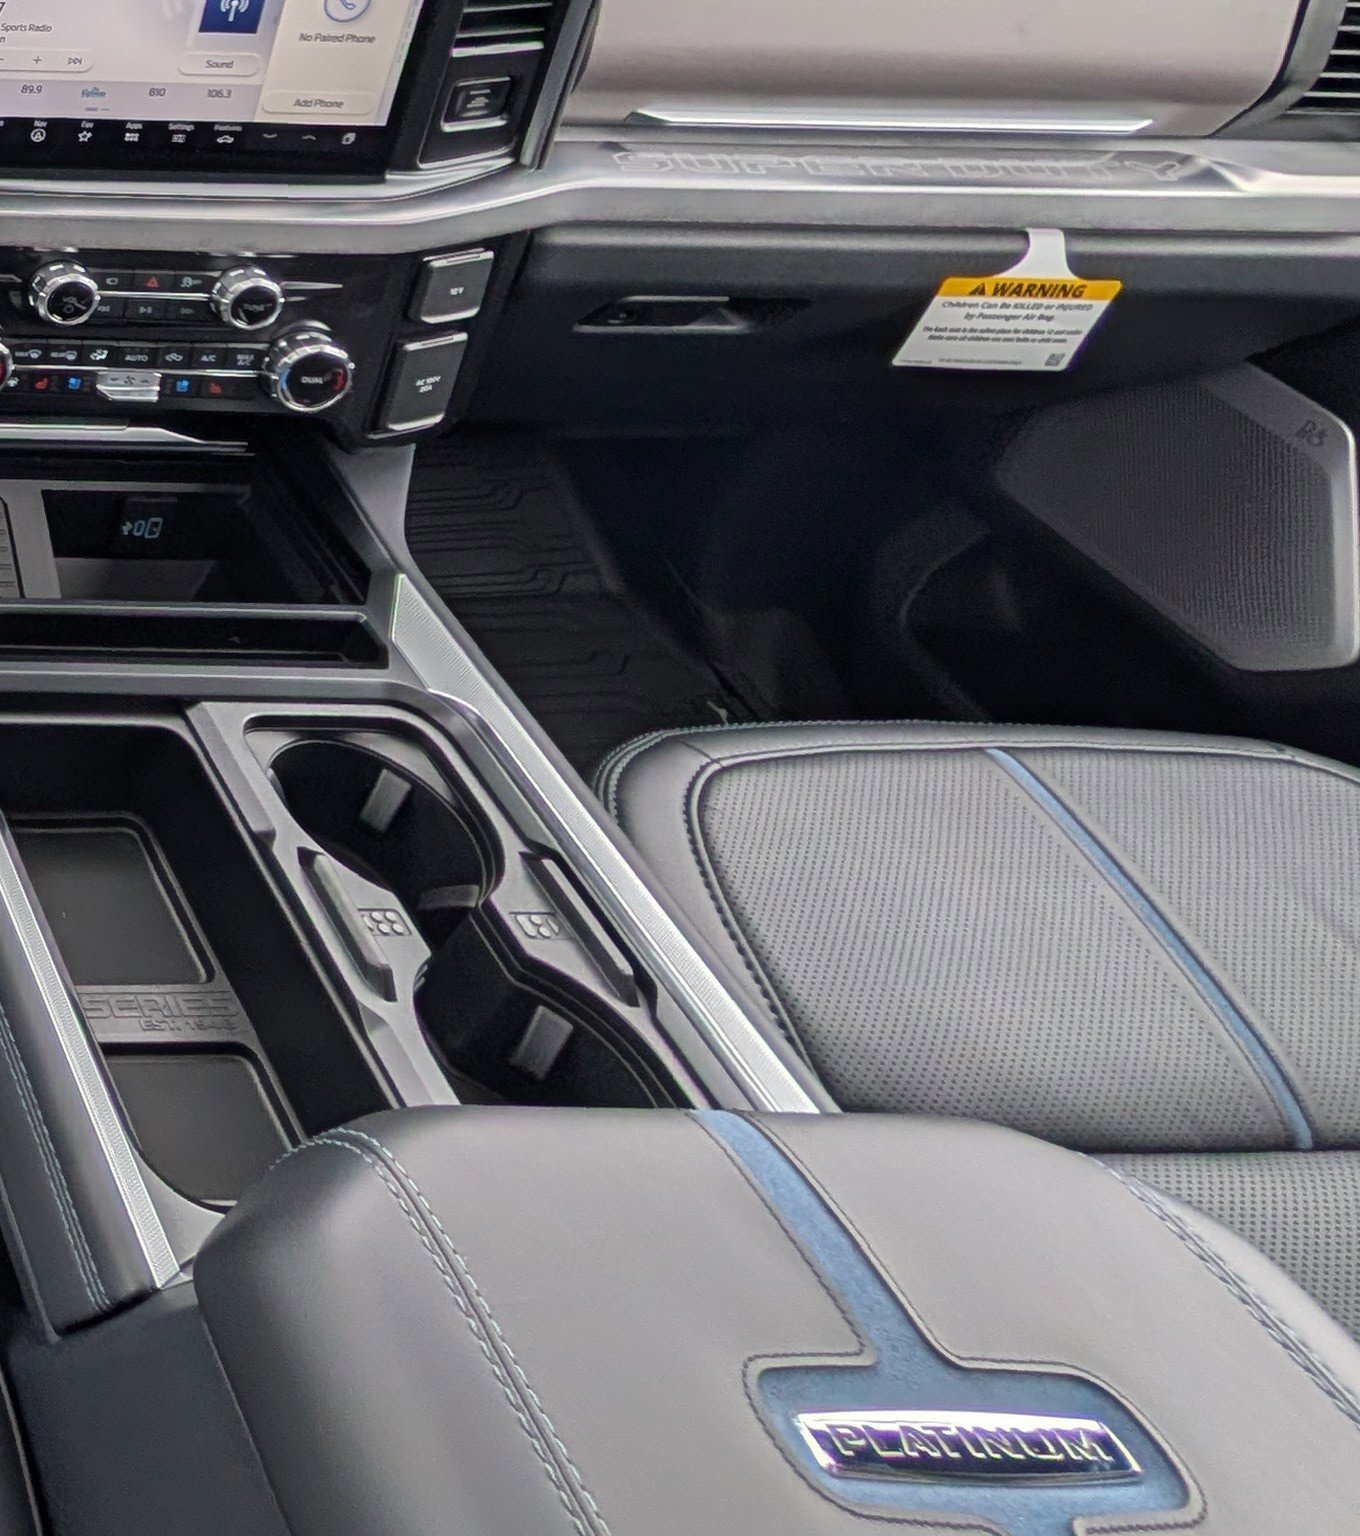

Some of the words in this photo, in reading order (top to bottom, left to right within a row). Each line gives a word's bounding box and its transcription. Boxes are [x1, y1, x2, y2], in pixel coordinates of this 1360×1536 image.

[0, 22, 28, 34] Sports
[28, 23, 53, 33] Radio
[299, 33, 313, 42] No
[314, 33, 344, 43] Paired
[345, 34, 376, 44] Phone
[205, 59, 234, 69] Sound
[20, 85, 43, 94] 89.9
[293, 99, 313, 108] Add
[313, 99, 344, 109] Phone
[992, 282, 1088, 298] WARNING
[942, 301, 979, 310] Children
[981, 302, 999, 310] Can
[124, 354, 149, 362] AUTO
[824, 1421, 1115, 1465] PLATINUM
